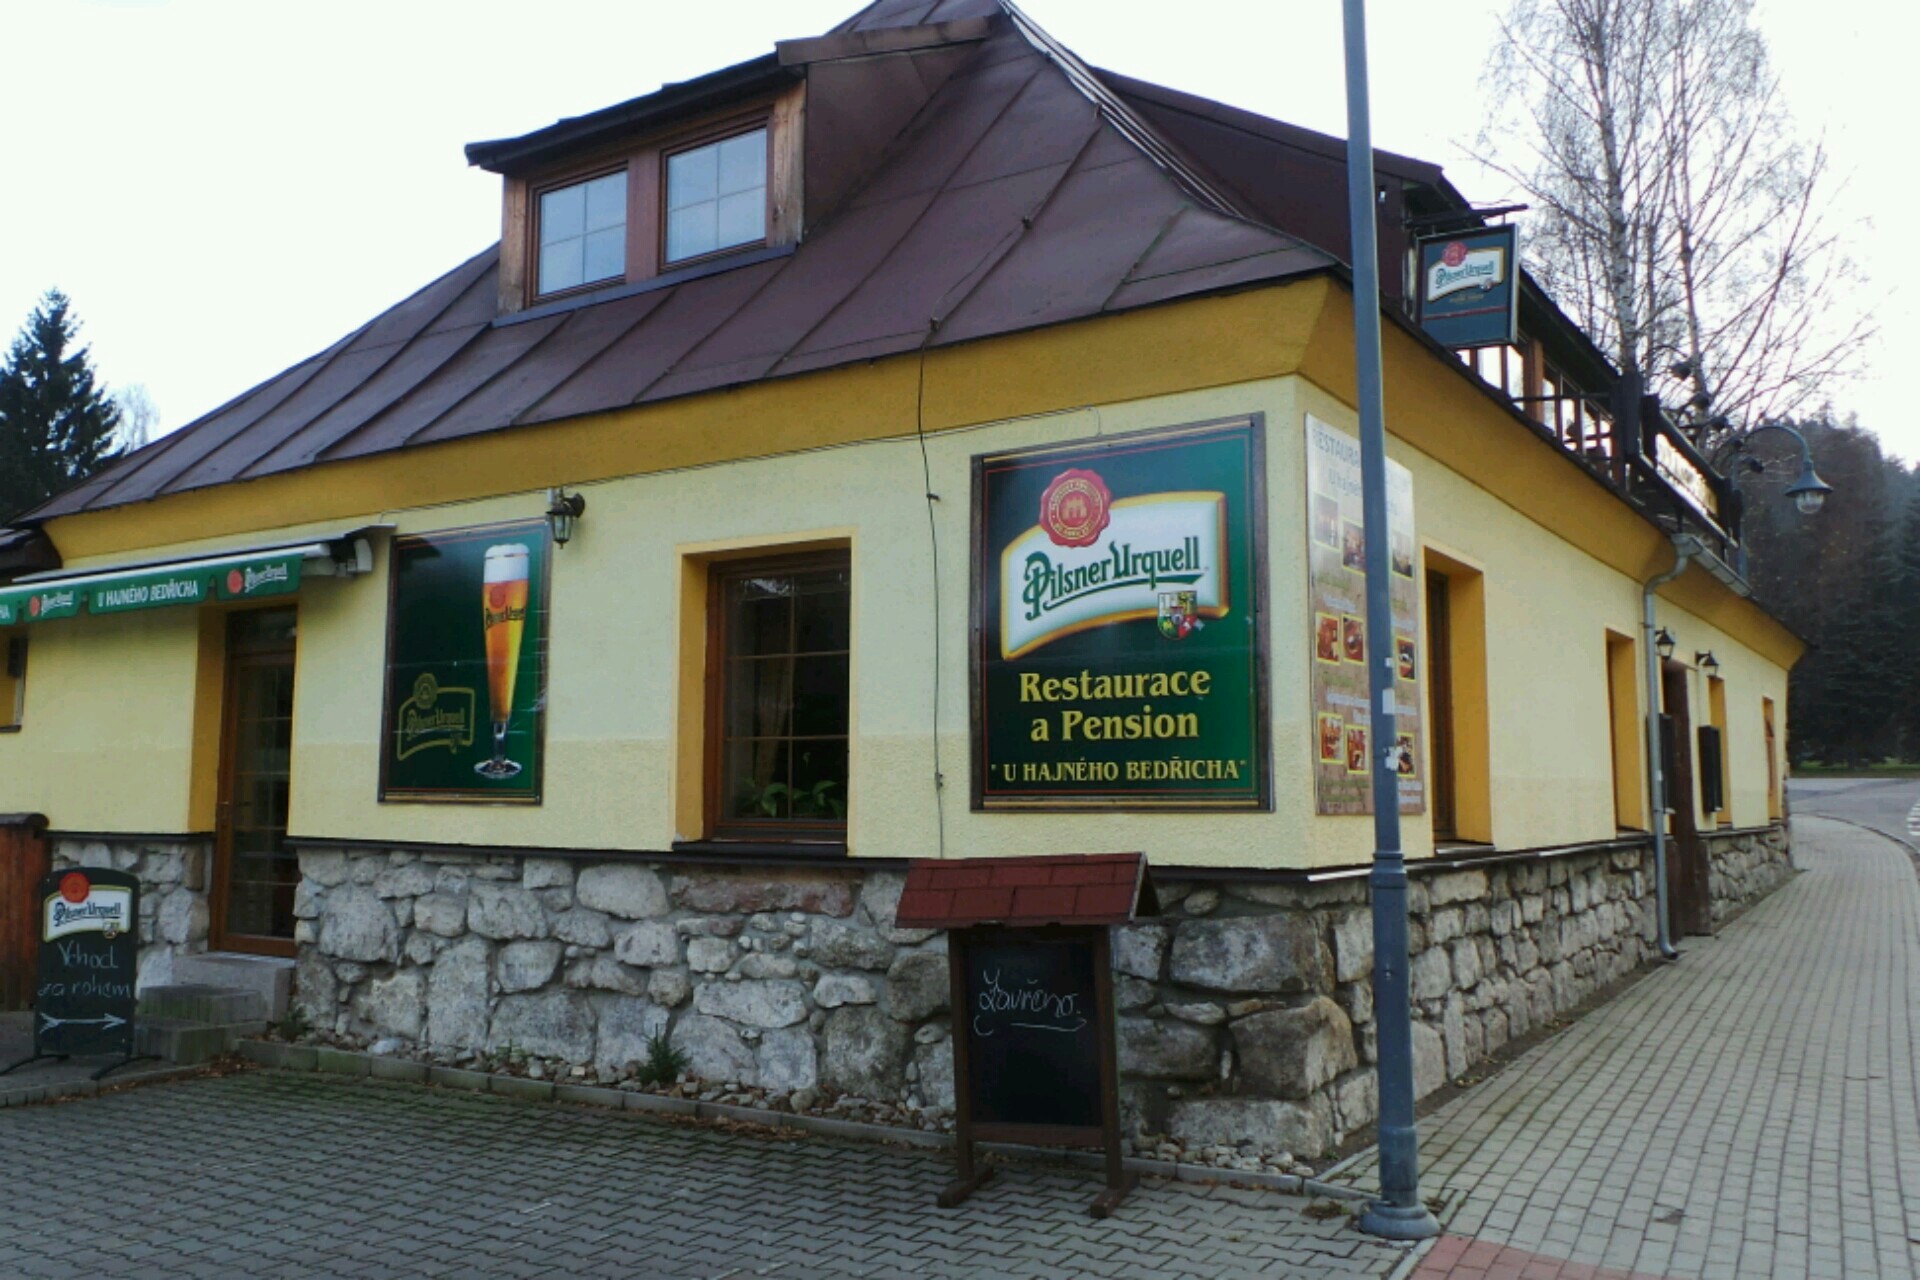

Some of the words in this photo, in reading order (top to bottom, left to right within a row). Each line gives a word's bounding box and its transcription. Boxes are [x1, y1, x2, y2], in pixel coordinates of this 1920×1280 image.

[1023, 550, 1112, 621] Pilsner
[1109, 536, 1200, 590] Urquell
[1019, 669, 1211, 702] Restaurace
[1030, 718, 1050, 741] a
[1061, 705, 1199, 741] Pension
[1023, 757, 1119, 781] HAJNÉHO
[57, 940, 119, 969] Vchod
[71, 974, 131, 998] rohem
